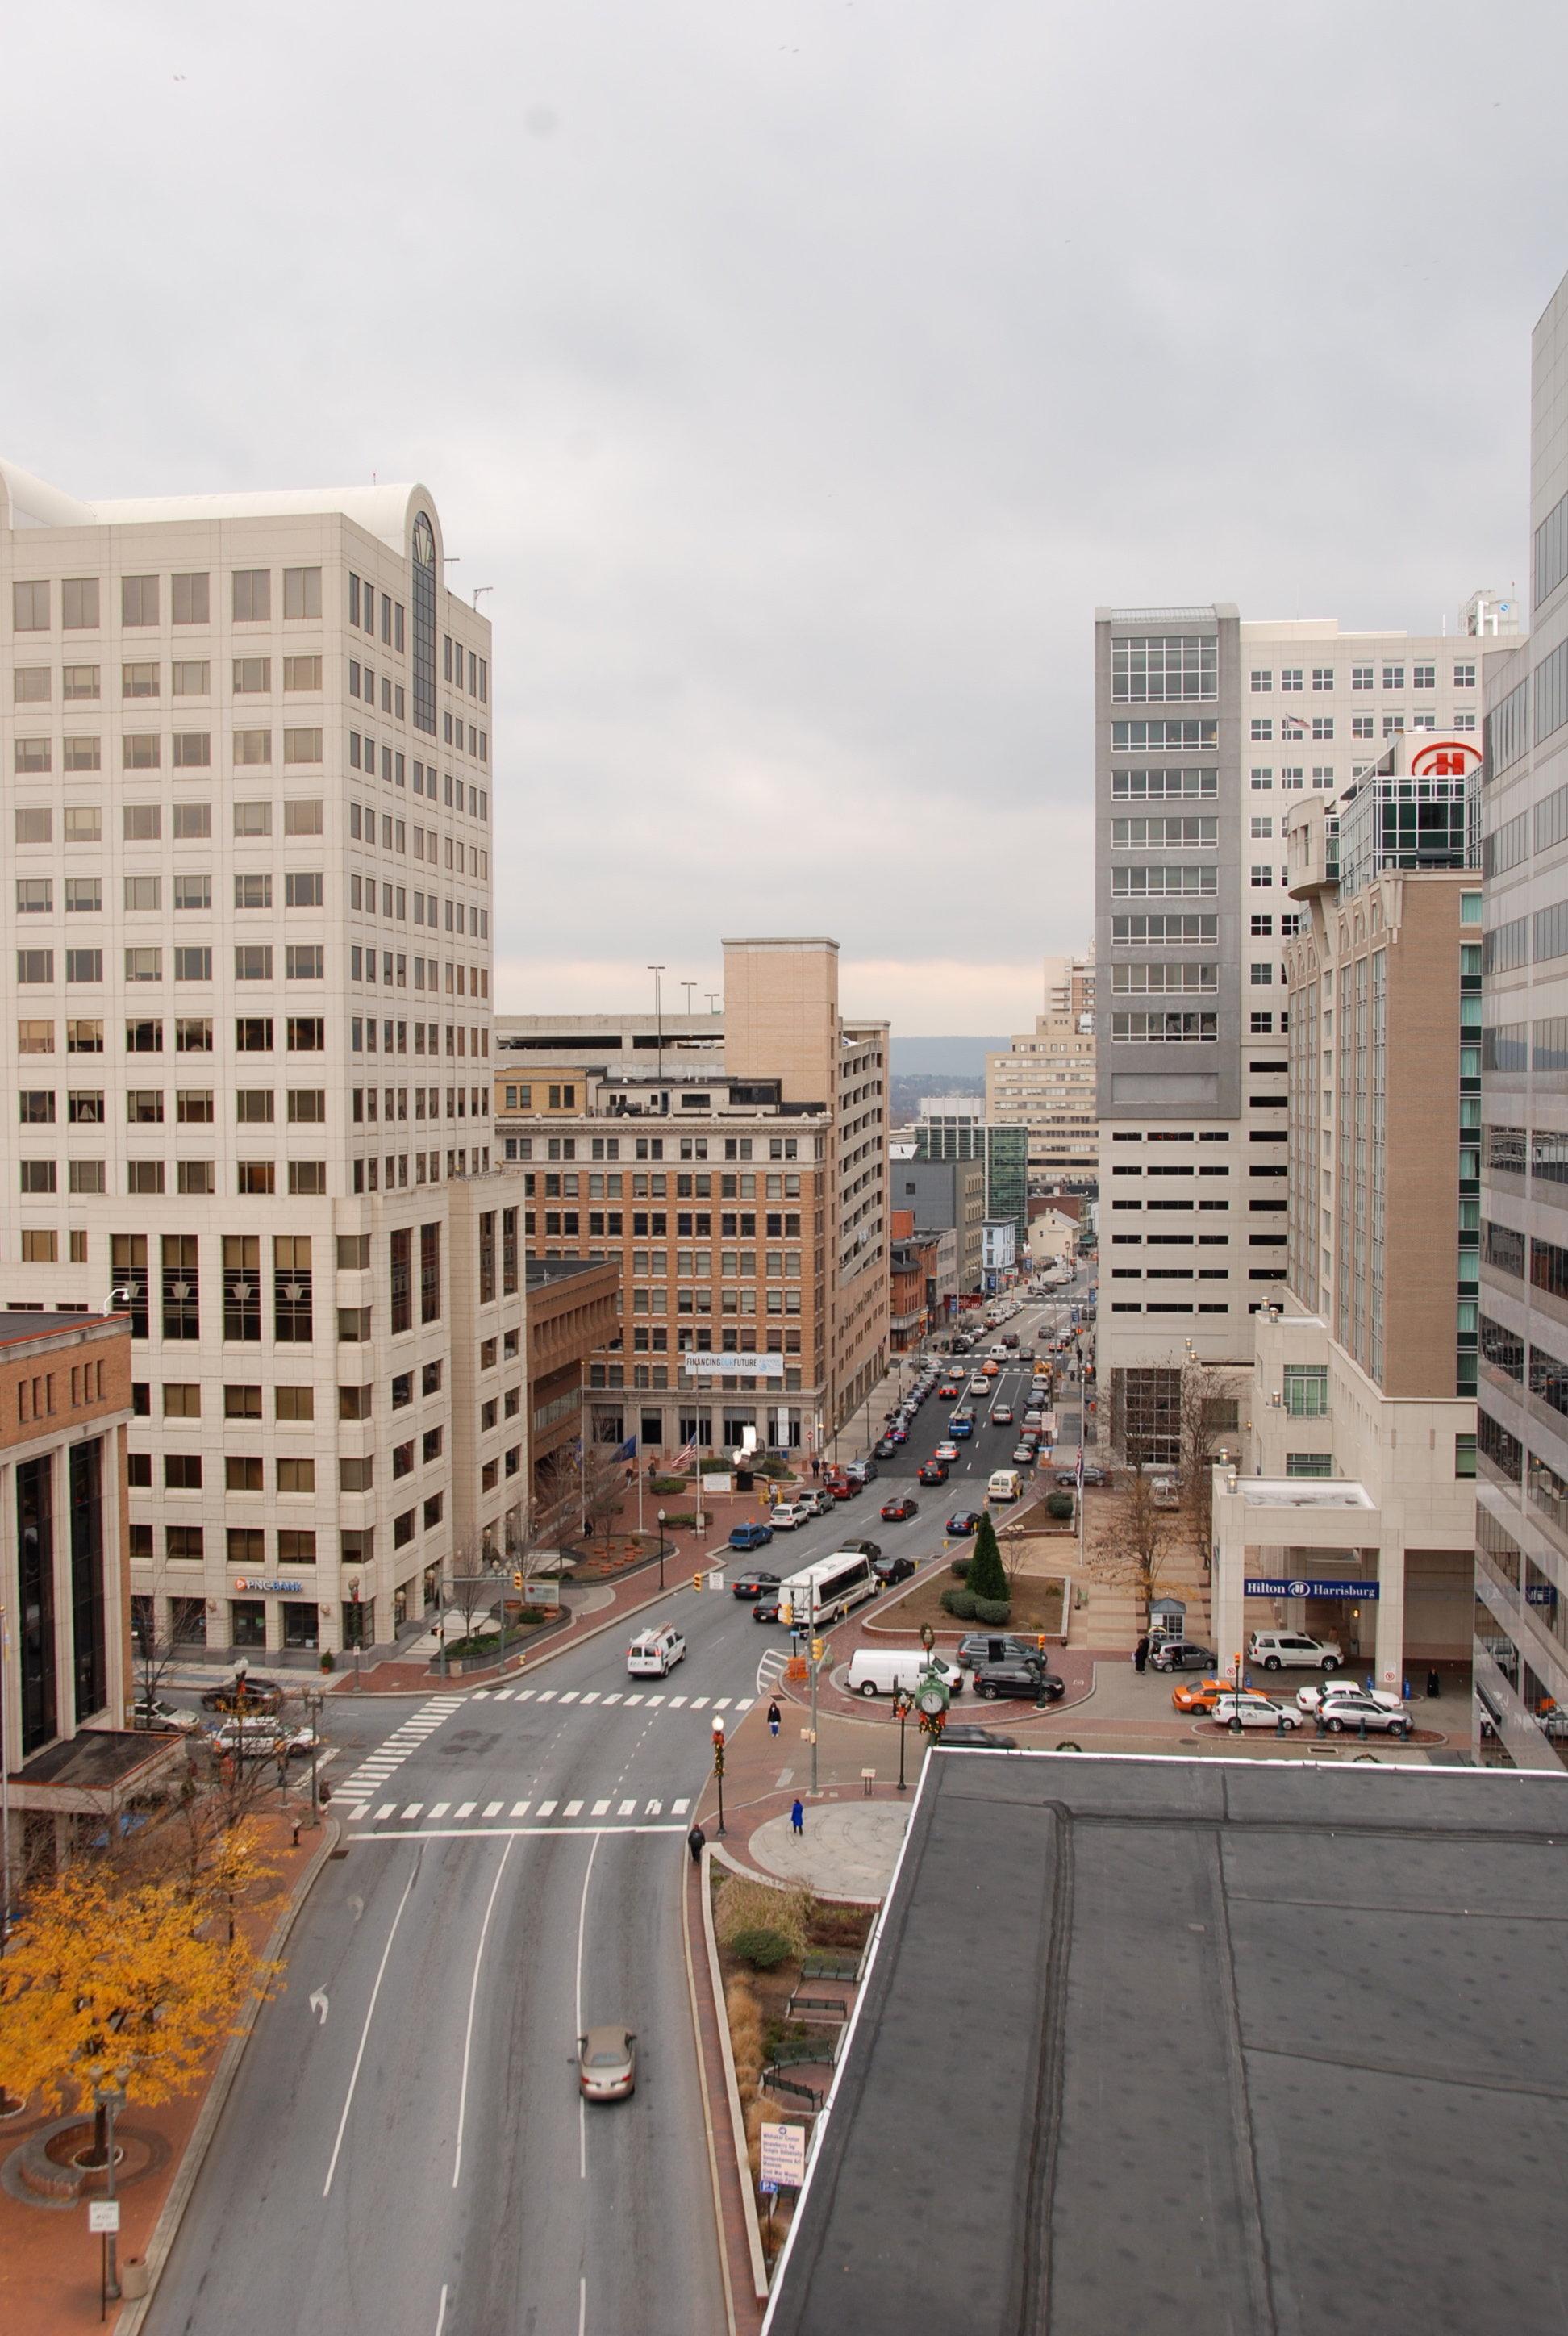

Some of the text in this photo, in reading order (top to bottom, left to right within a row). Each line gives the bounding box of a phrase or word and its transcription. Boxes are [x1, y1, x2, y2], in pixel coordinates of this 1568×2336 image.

[247, 1580, 302, 1592] PNC BANK
[1247, 1583, 1285, 1594] Hilton
[1313, 1585, 1375, 1599] Harrisburg
